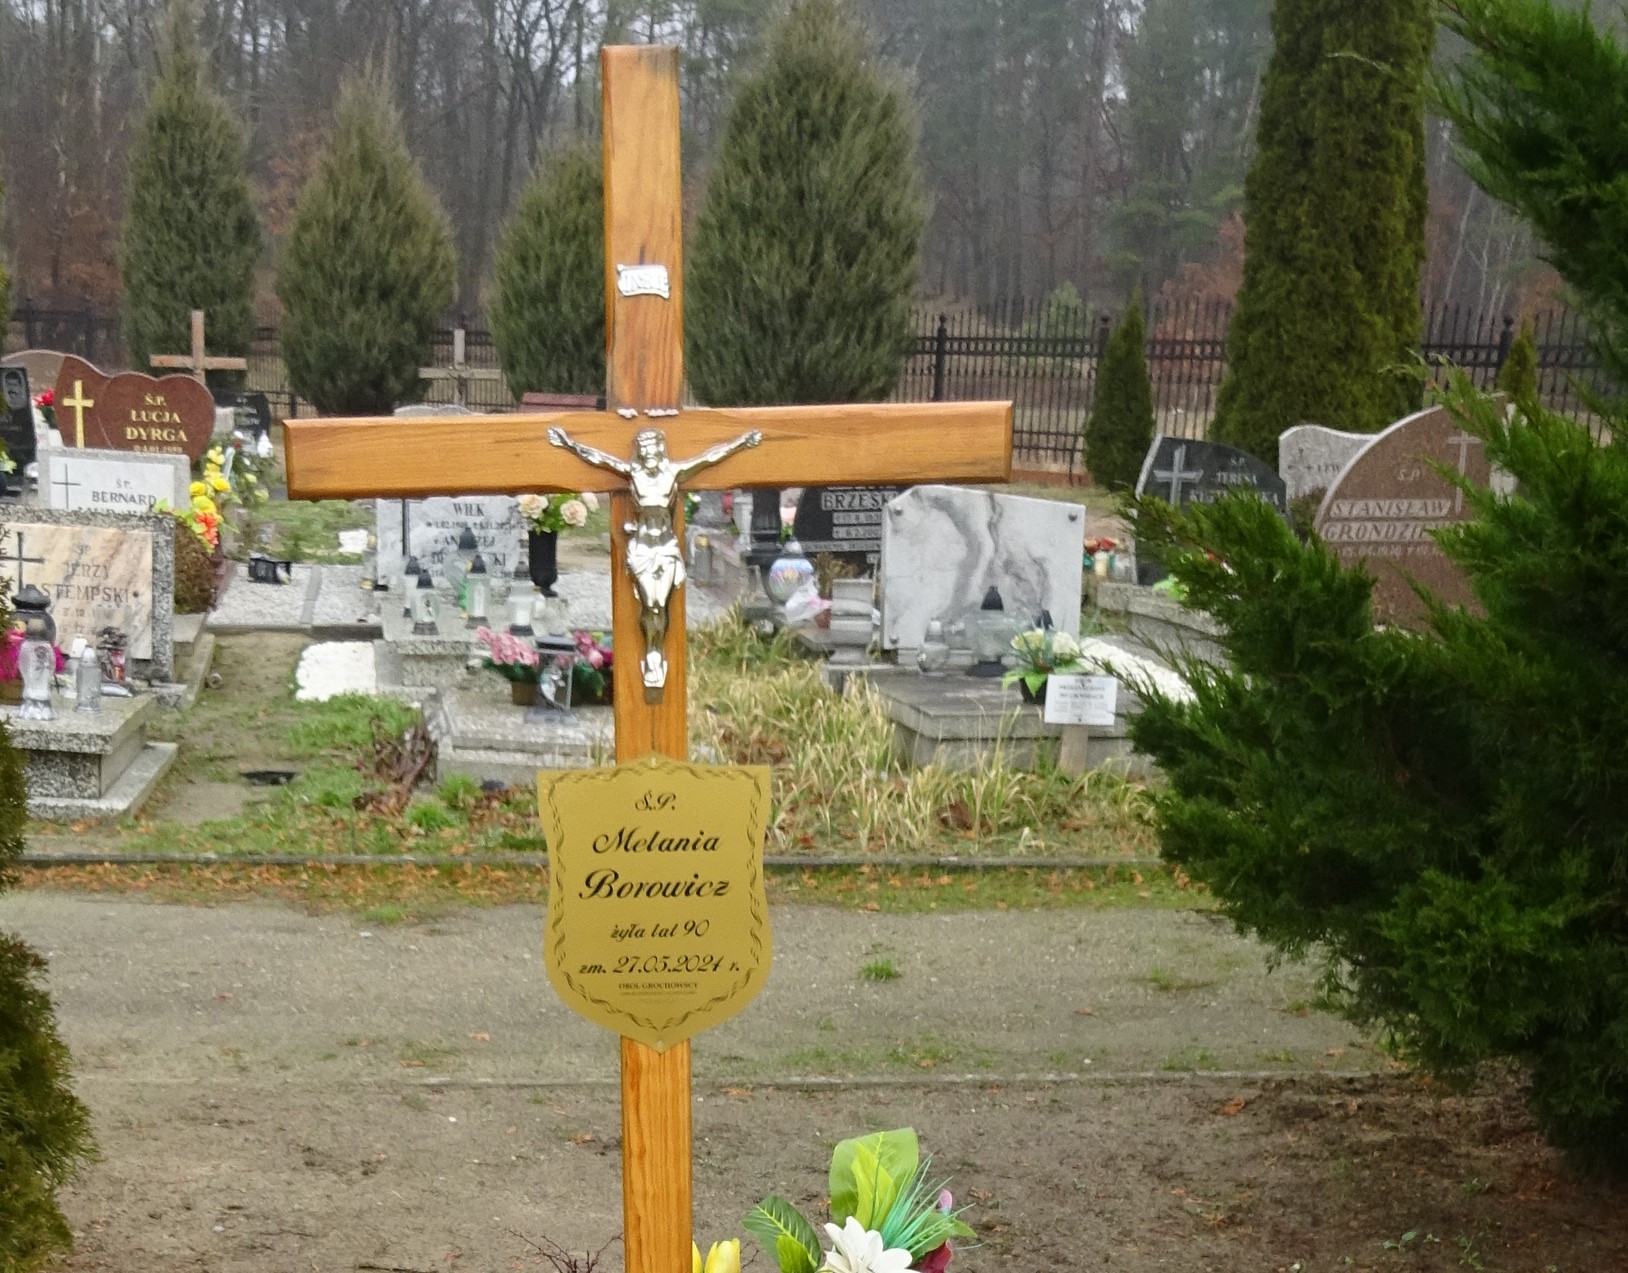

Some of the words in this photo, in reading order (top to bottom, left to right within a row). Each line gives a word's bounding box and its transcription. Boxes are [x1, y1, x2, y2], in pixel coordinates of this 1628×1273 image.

[125, 426, 188, 442] DYRGA
[92, 491, 157, 506] BERNARD
[592, 826, 720, 854] Melania
[578, 867, 730, 899] Borowicz
[610, 924, 646, 942] żyła
[651, 923, 679, 938] lat
[684, 919, 710, 938] 90
[578, 964, 607, 974] zm.
[729, 961, 740, 972] r.
